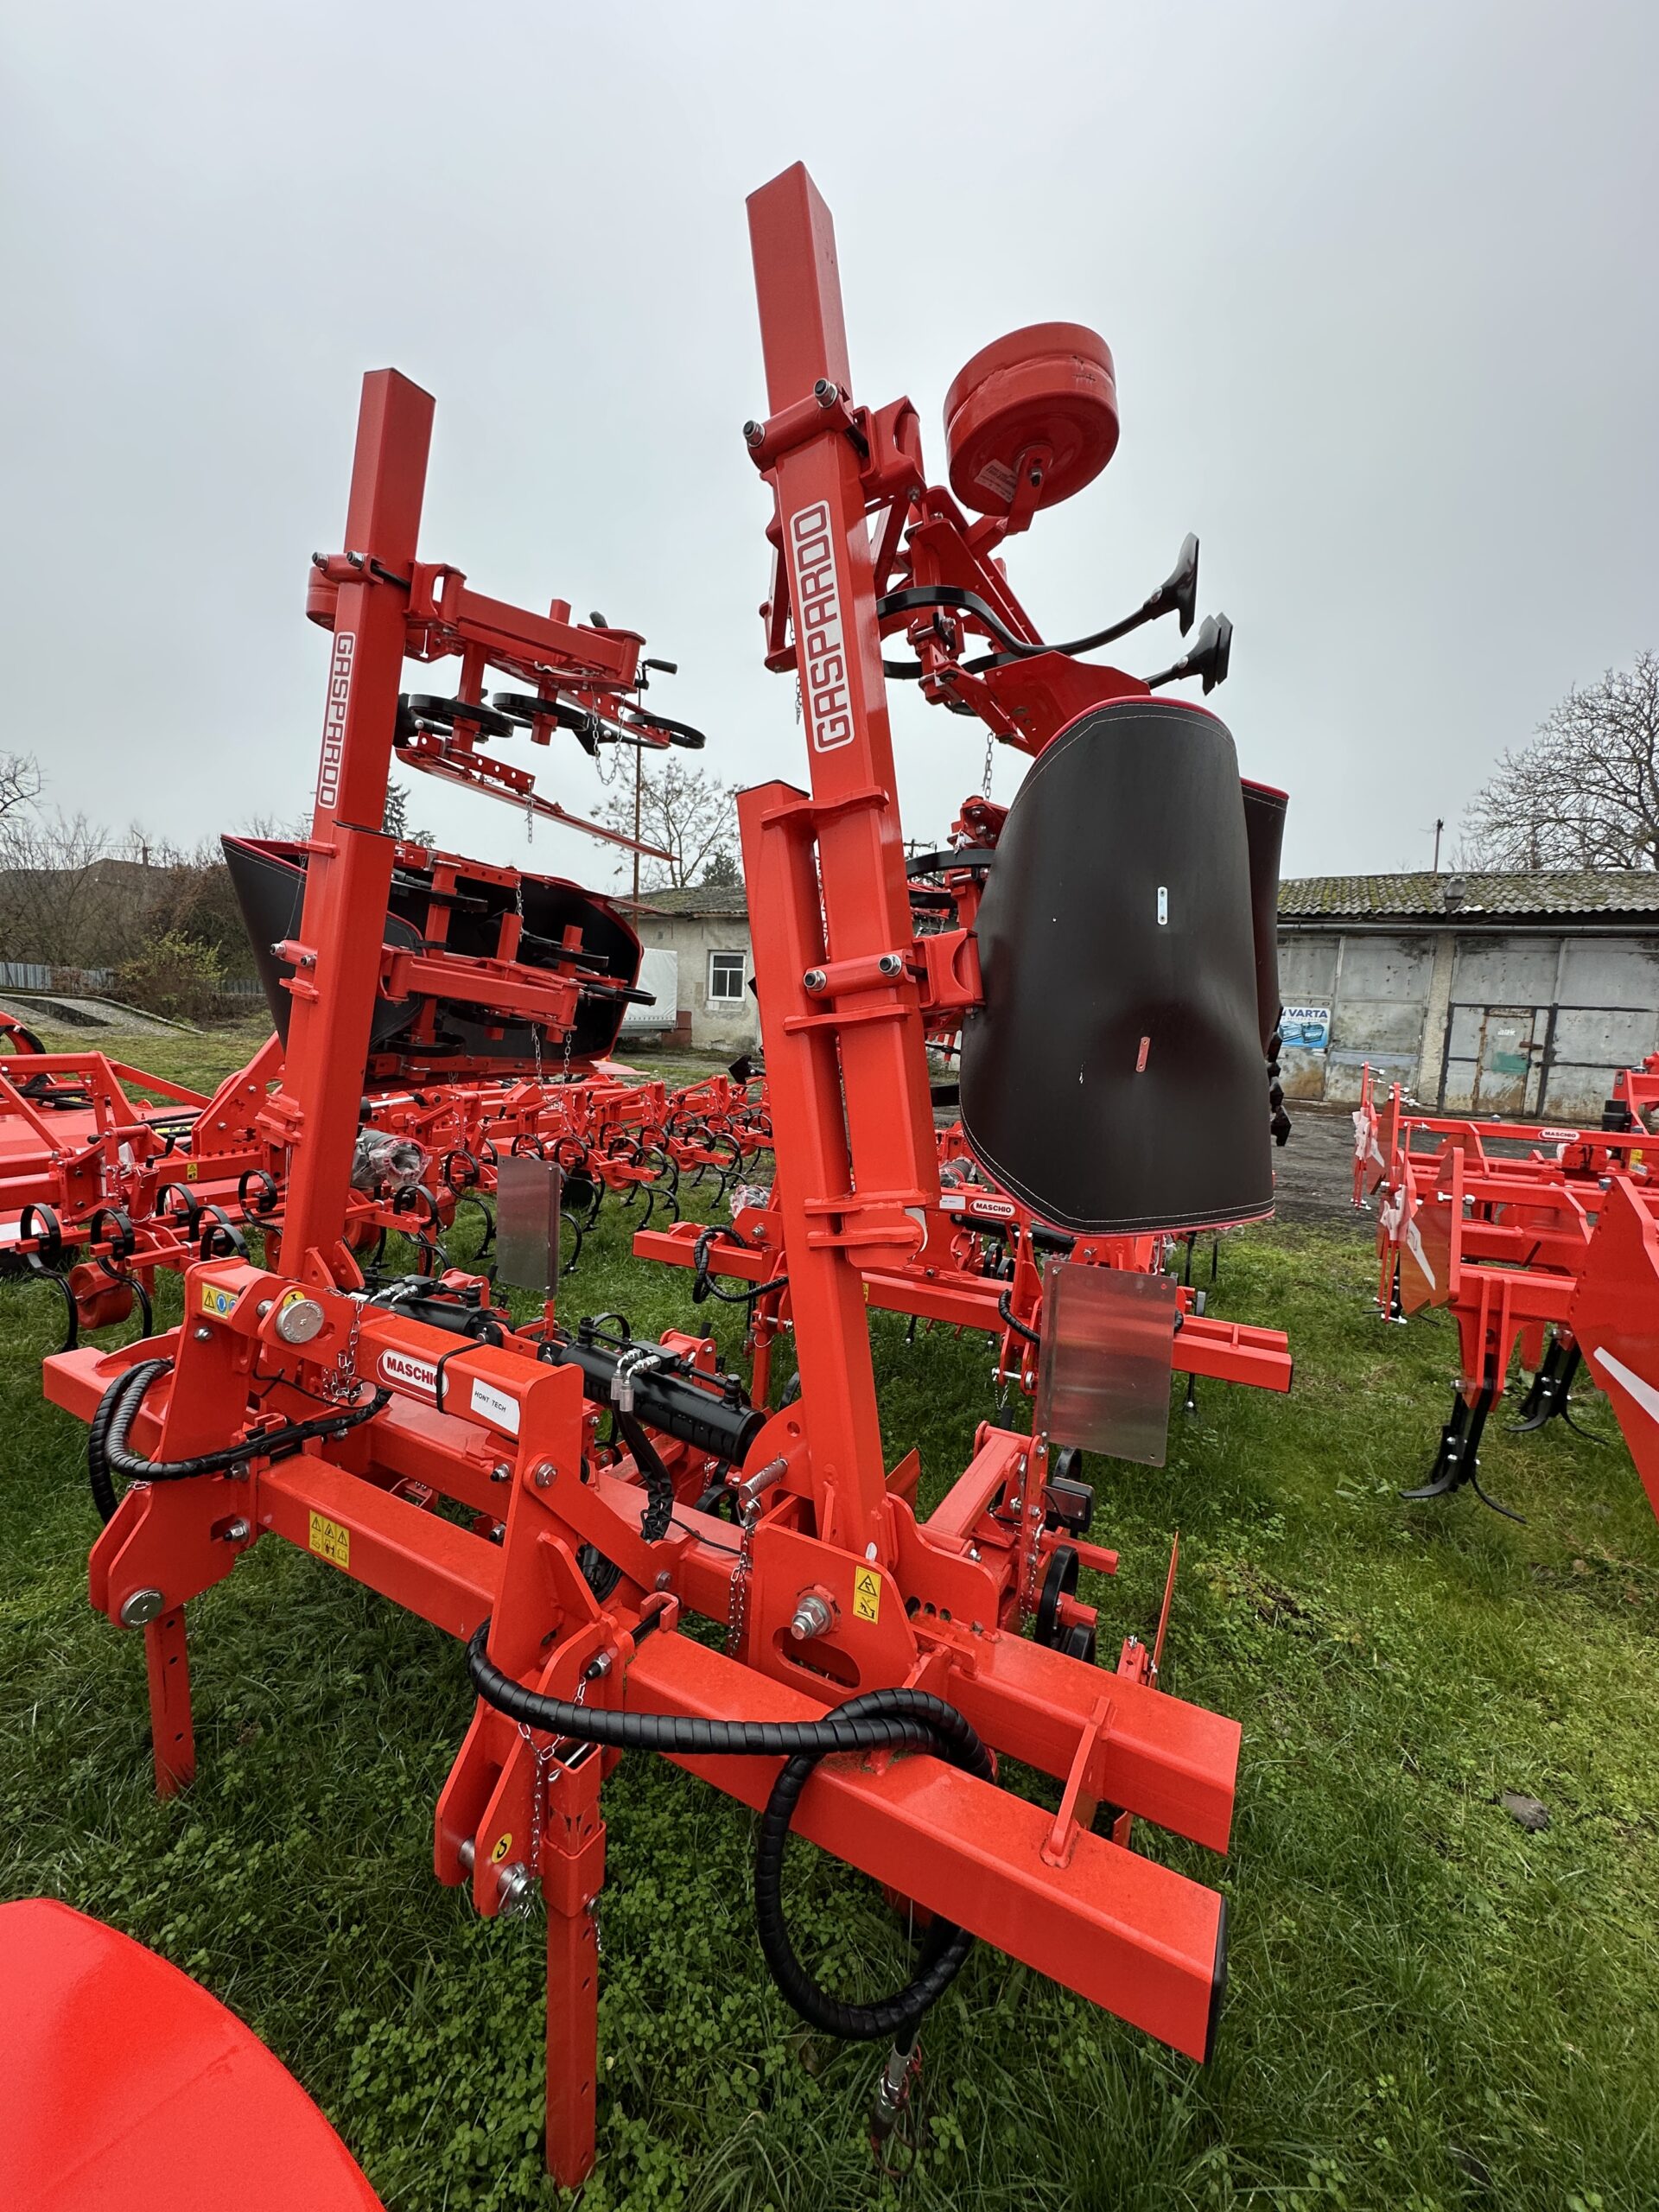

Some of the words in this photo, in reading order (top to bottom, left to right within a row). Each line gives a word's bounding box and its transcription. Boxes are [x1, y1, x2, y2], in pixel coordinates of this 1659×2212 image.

[792, 504, 852, 750] GASPARDO
[319, 634, 354, 807] GASPARDO
[1288, 1008, 1328, 1019] VARTA
[976, 1202, 1012, 1213] MASCHIO
[492, 1400, 506, 1413] TECH
